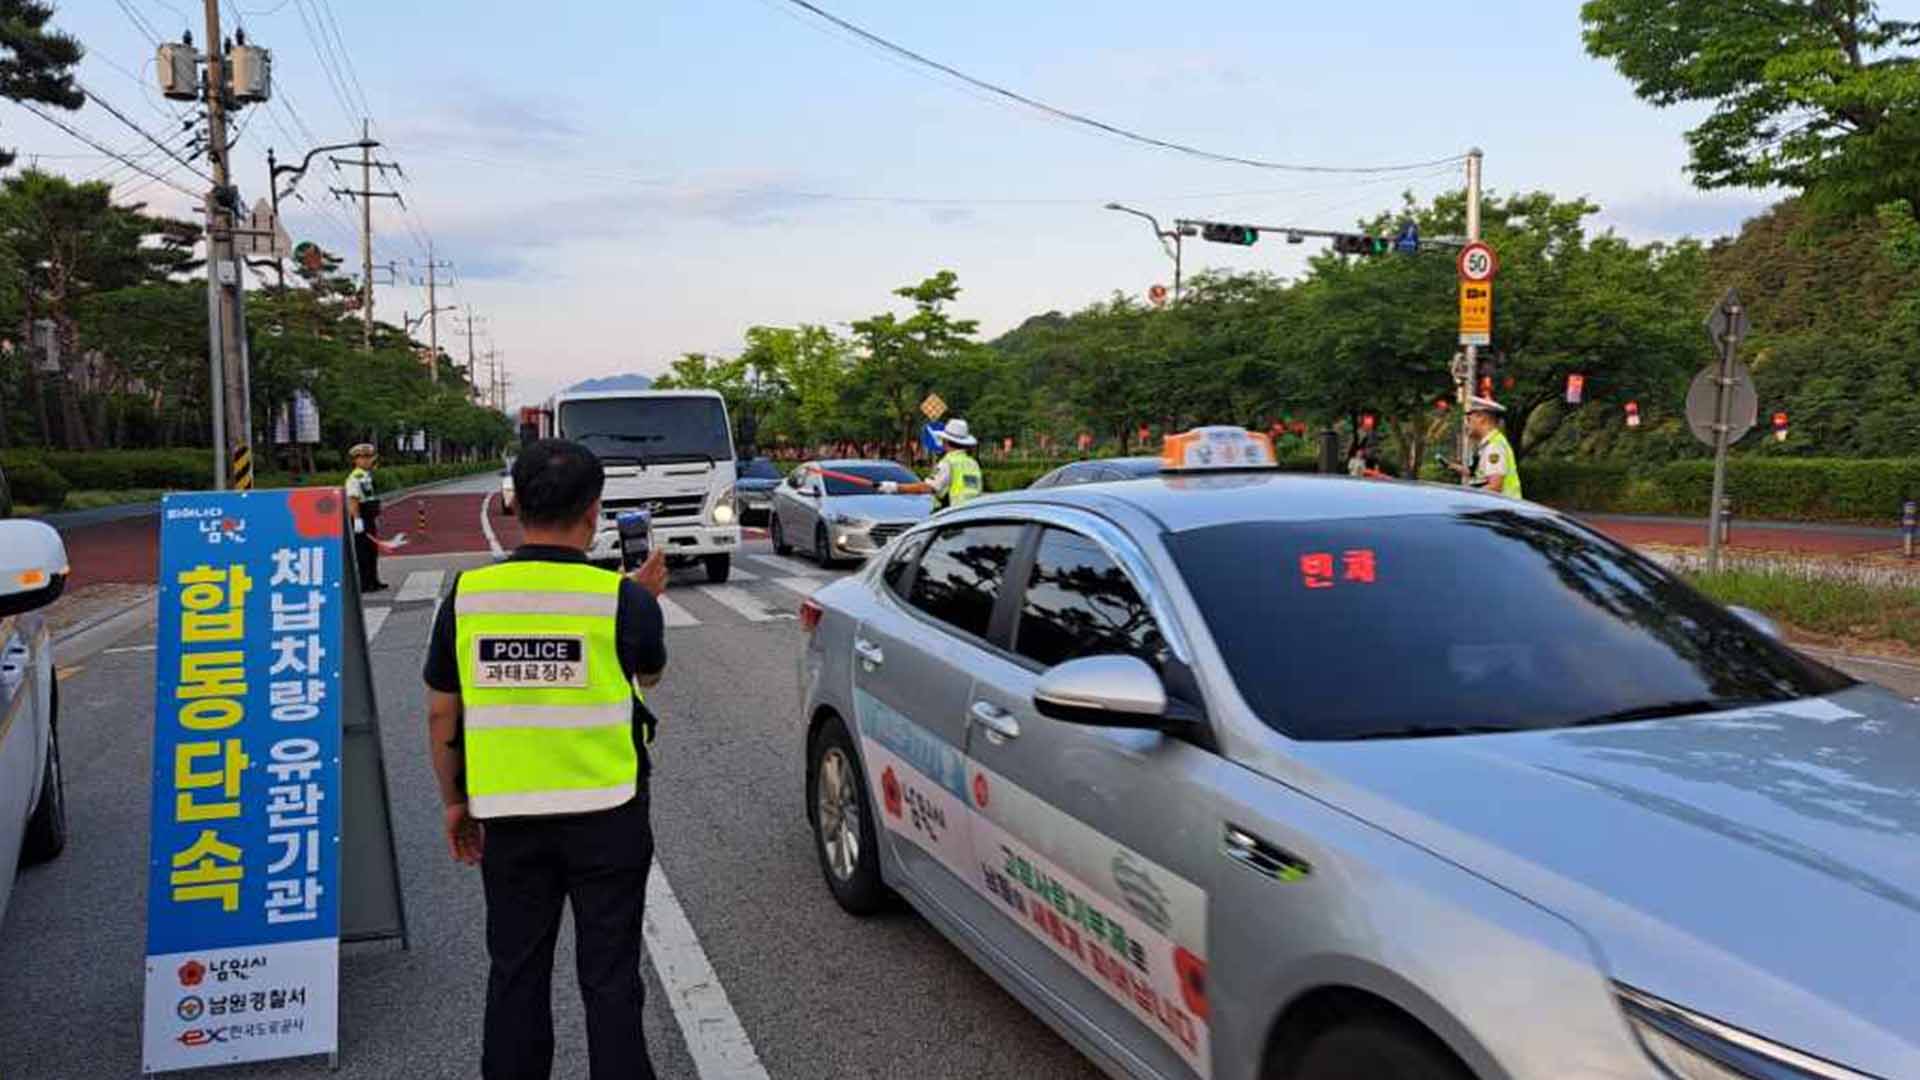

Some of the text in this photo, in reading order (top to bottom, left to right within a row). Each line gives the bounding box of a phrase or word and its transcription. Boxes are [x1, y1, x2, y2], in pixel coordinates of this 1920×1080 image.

[1468, 252, 1488, 273] 50
[199, 518, 247, 544] 남원
[493, 642, 569, 659] POLICE
[485, 664, 575, 682] 과태료징수
[170, 565, 253, 912] 합동단속
[265, 546, 327, 924] 체납차량 유관기관
[209, 956, 267, 981] 남원시
[209, 986, 306, 1016] 남원경찰서
